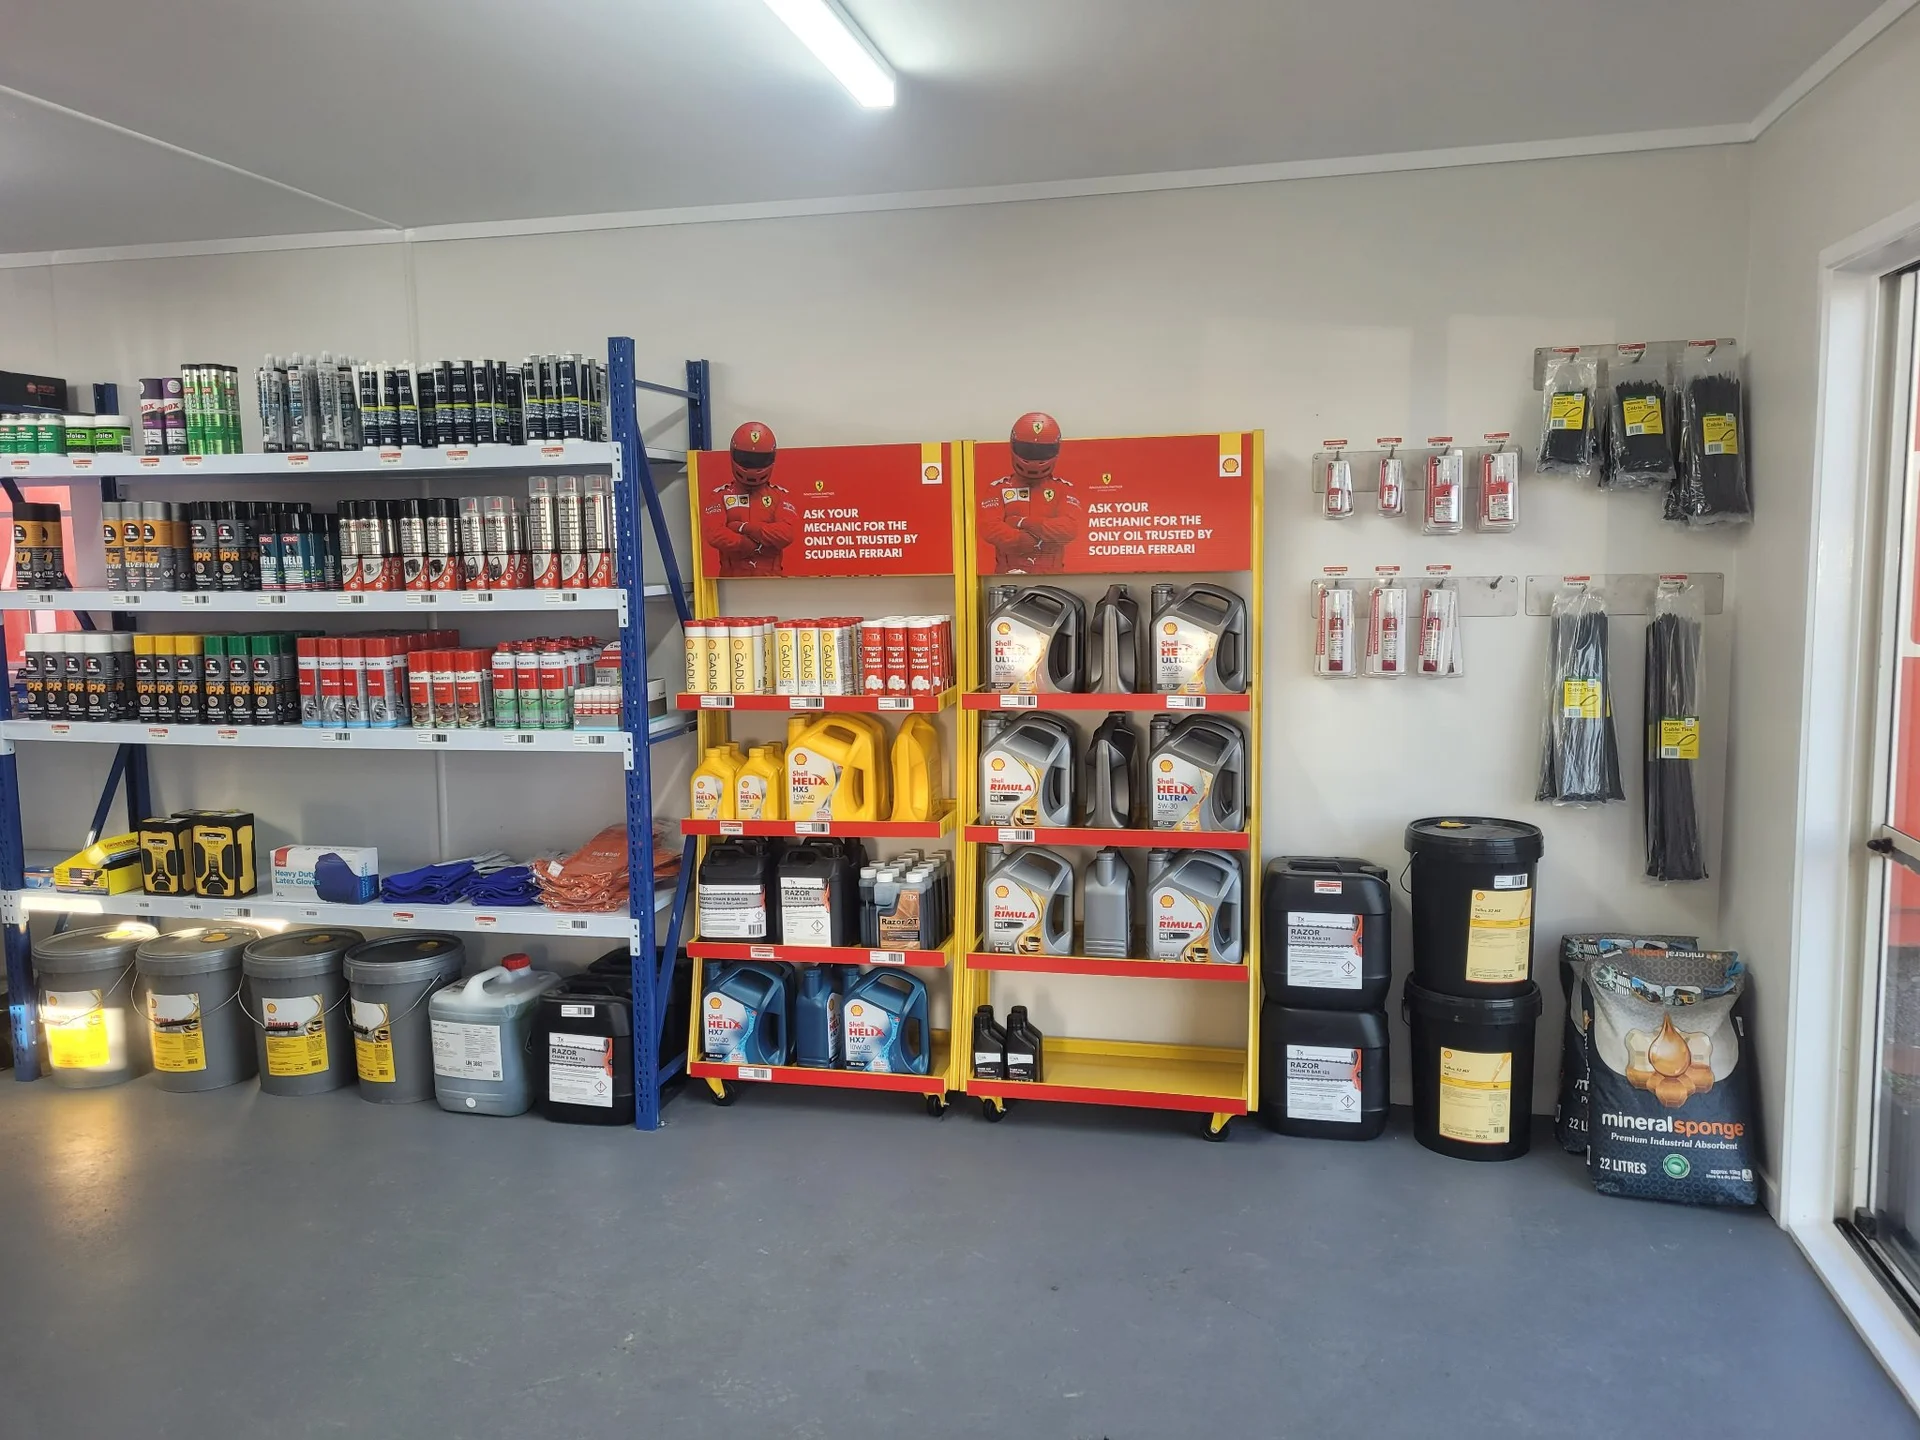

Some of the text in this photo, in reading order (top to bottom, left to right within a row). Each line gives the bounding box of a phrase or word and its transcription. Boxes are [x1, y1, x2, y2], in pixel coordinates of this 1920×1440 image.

[804, 508, 859, 519] ASK YOUR
[1088, 502, 1149, 514] ASK YOUR
[804, 521, 907, 532] MECHANIC FOR THE
[1088, 515, 1201, 527] MECHANIC FOR THE
[804, 534, 918, 546] ONLY OIL TRUSTED BY
[1088, 529, 1213, 542] ONLY OIL TRUSTED BY
[805, 548, 903, 560] SCUDERIA FERRARI
[1088, 544, 1195, 556] SCUDERIA FERRARI
[283, 555, 303, 565] WELD
[780, 644, 791, 679] GADUS
[803, 644, 813, 679] GADUS
[823, 644, 833, 679] GADUS
[686, 652, 695, 691] GADUS
[708, 652, 718, 691] GADUS
[734, 652, 745, 691] GADUS
[793, 776, 829, 786] HELIX
[1157, 785, 1197, 794] HELIX
[298, 870, 315, 878] Duty
[1159, 921, 1203, 929] RIMULA
[708, 1020, 743, 1029] HELIX
[849, 1028, 885, 1037] HELIX
[551, 1048, 577, 1056] RAZOR
[1290, 1061, 1319, 1069] RAZOR
[1569, 1117, 1578, 1130] 22
[1611, 1132, 1738, 1150] Premium Industrial Absorbent
[1600, 1157, 1647, 1175] 22 LITRES
